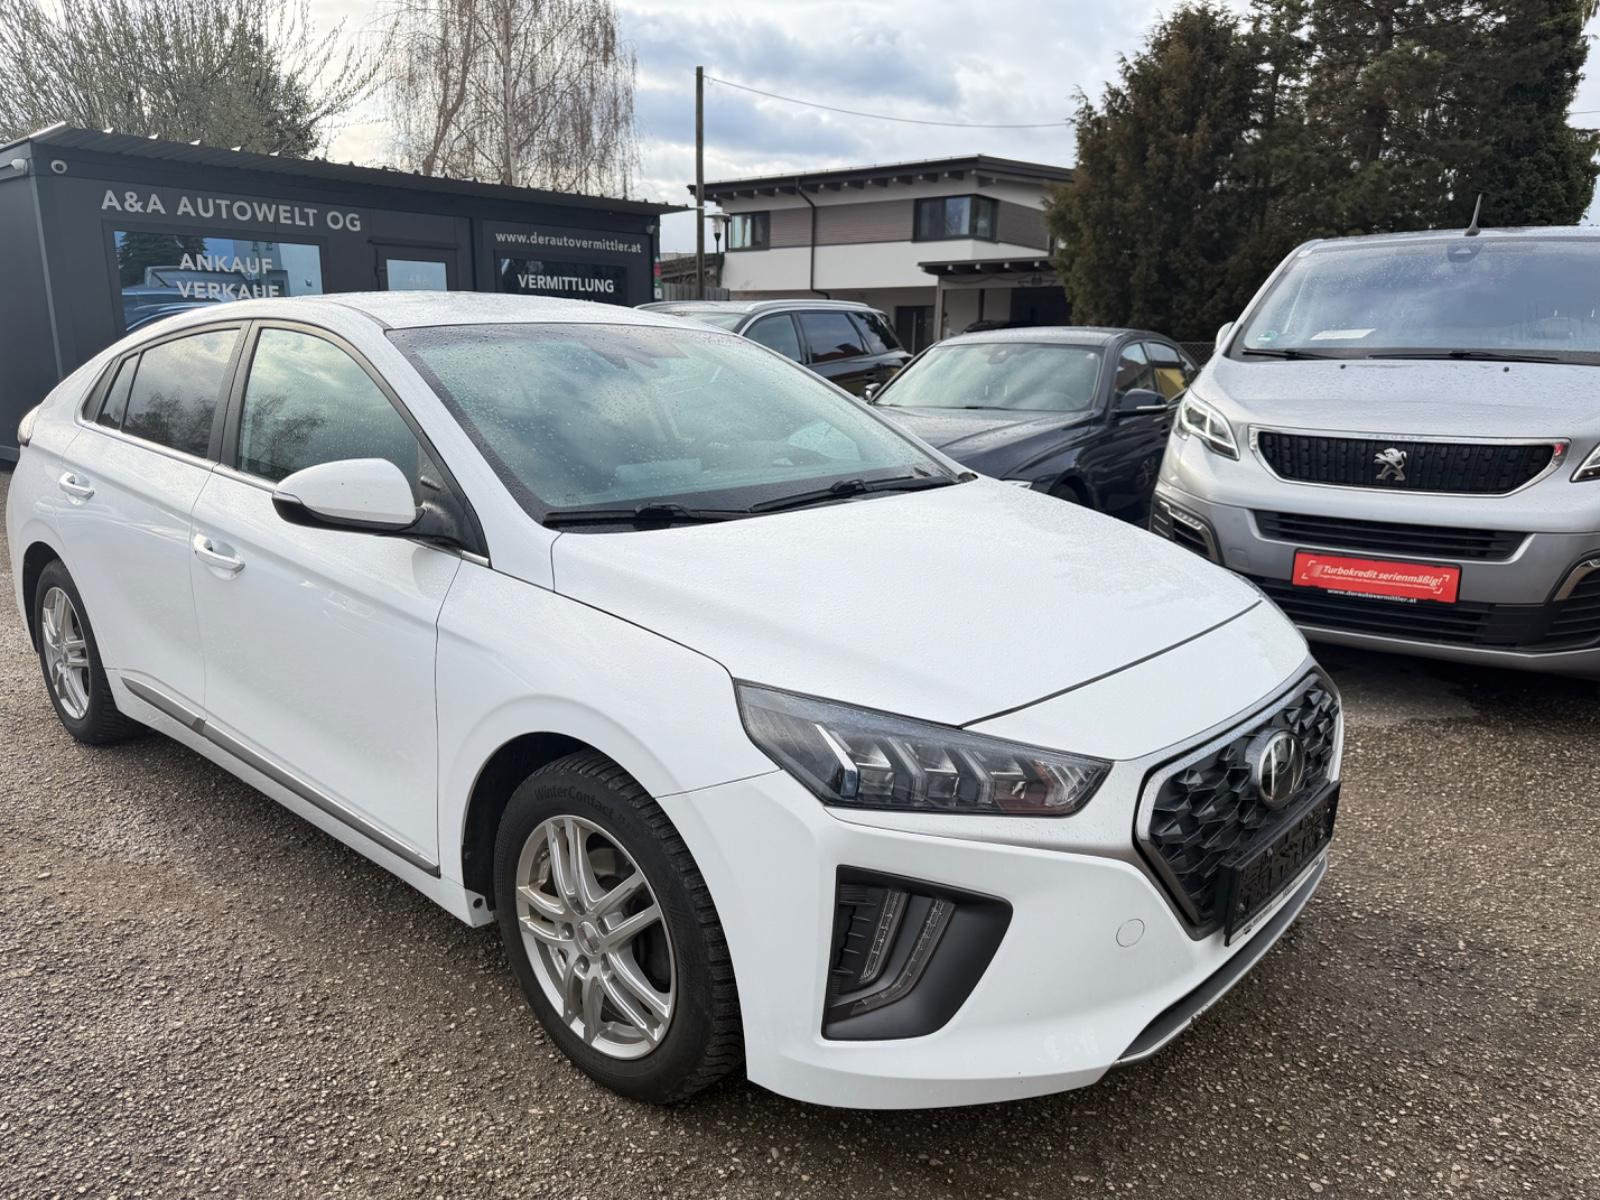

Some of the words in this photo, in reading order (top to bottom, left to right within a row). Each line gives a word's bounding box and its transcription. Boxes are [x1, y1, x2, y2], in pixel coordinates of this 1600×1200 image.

[101, 189, 166, 215] A&A
[176, 196, 317, 227] AUTOWELT
[326, 211, 361, 232] OG
[495, 231, 642, 253] www.derautovermittler.at
[179, 253, 273, 275] ANKAUF
[176, 280, 280, 299] VERKAUF
[517, 273, 614, 293] VERMITTLUNG
[1322, 565, 1376, 579] Turbokredit
[1378, 573, 1442, 587] serienmäßig!
